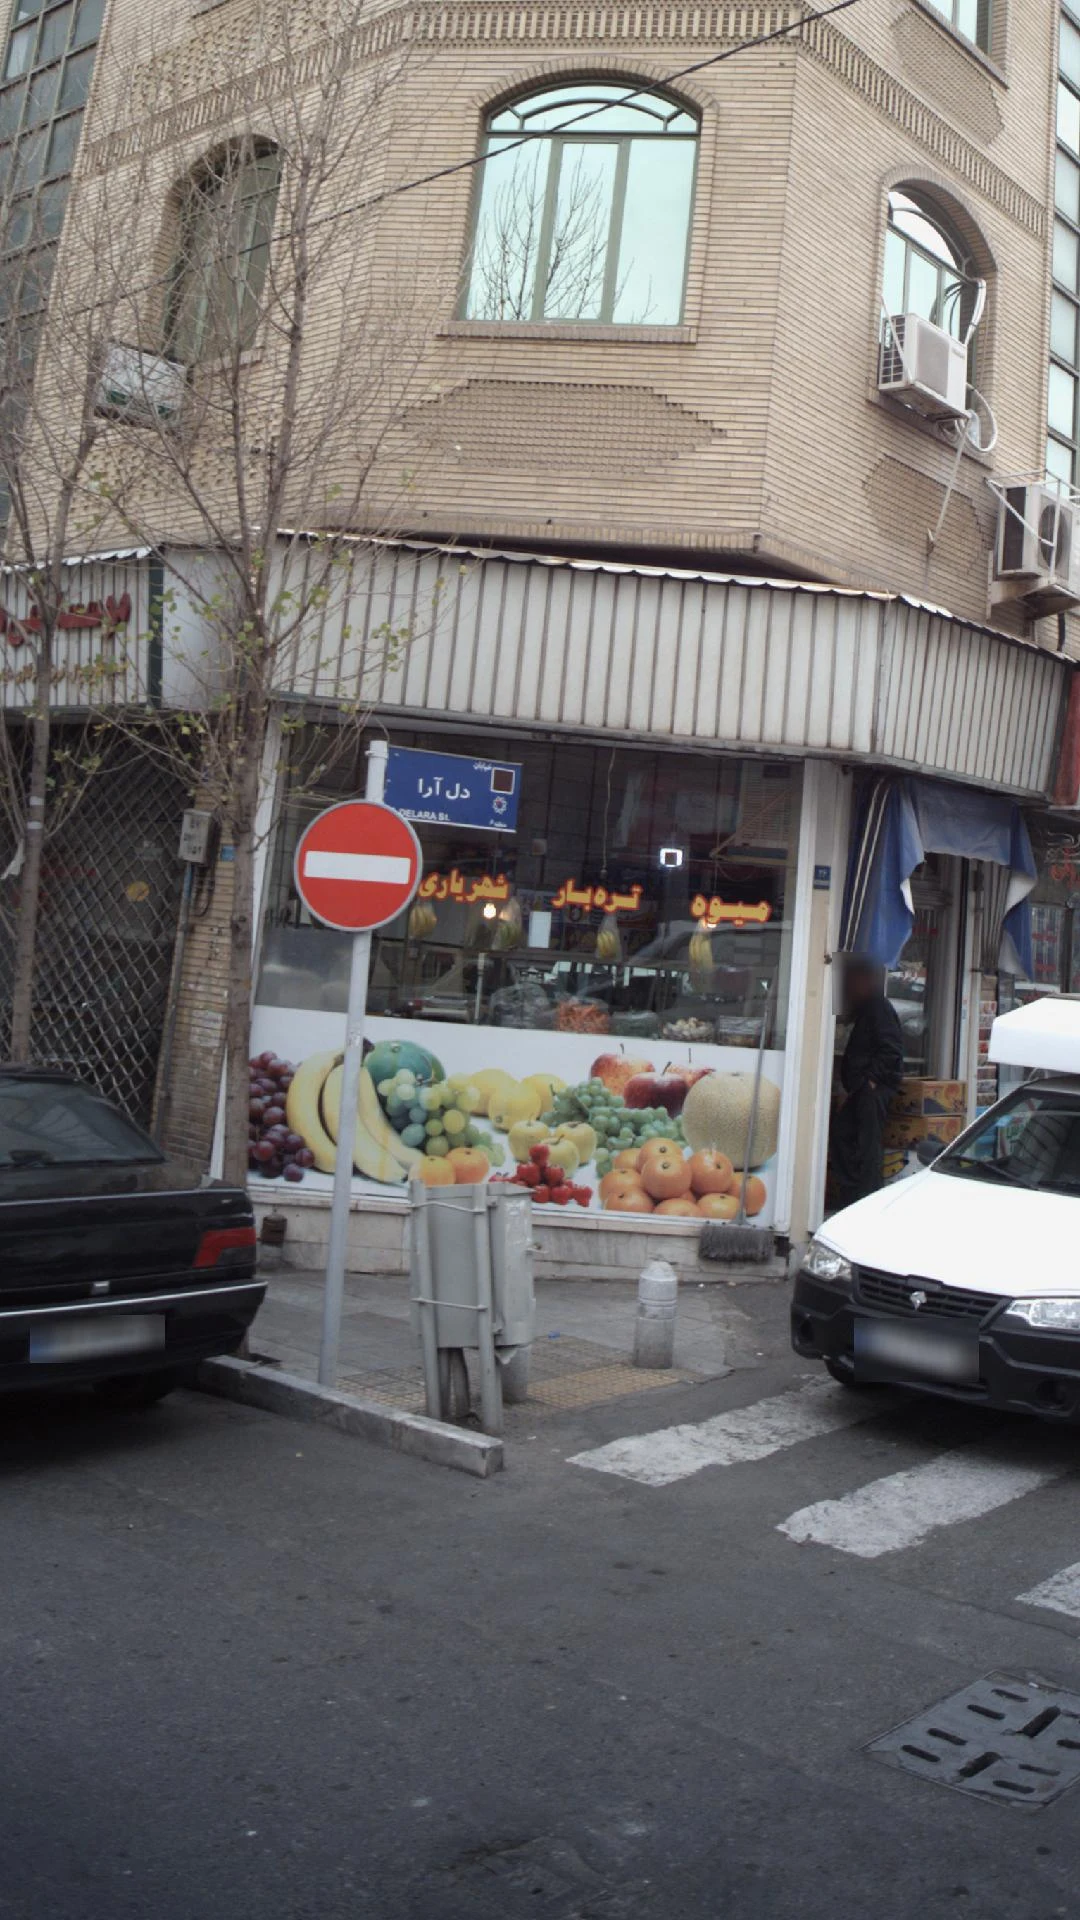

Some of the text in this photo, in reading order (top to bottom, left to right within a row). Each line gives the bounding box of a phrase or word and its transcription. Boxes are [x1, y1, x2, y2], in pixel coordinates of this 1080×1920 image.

[417, 776, 471, 800] دل آرا
[690, 893, 772, 926] میوه
